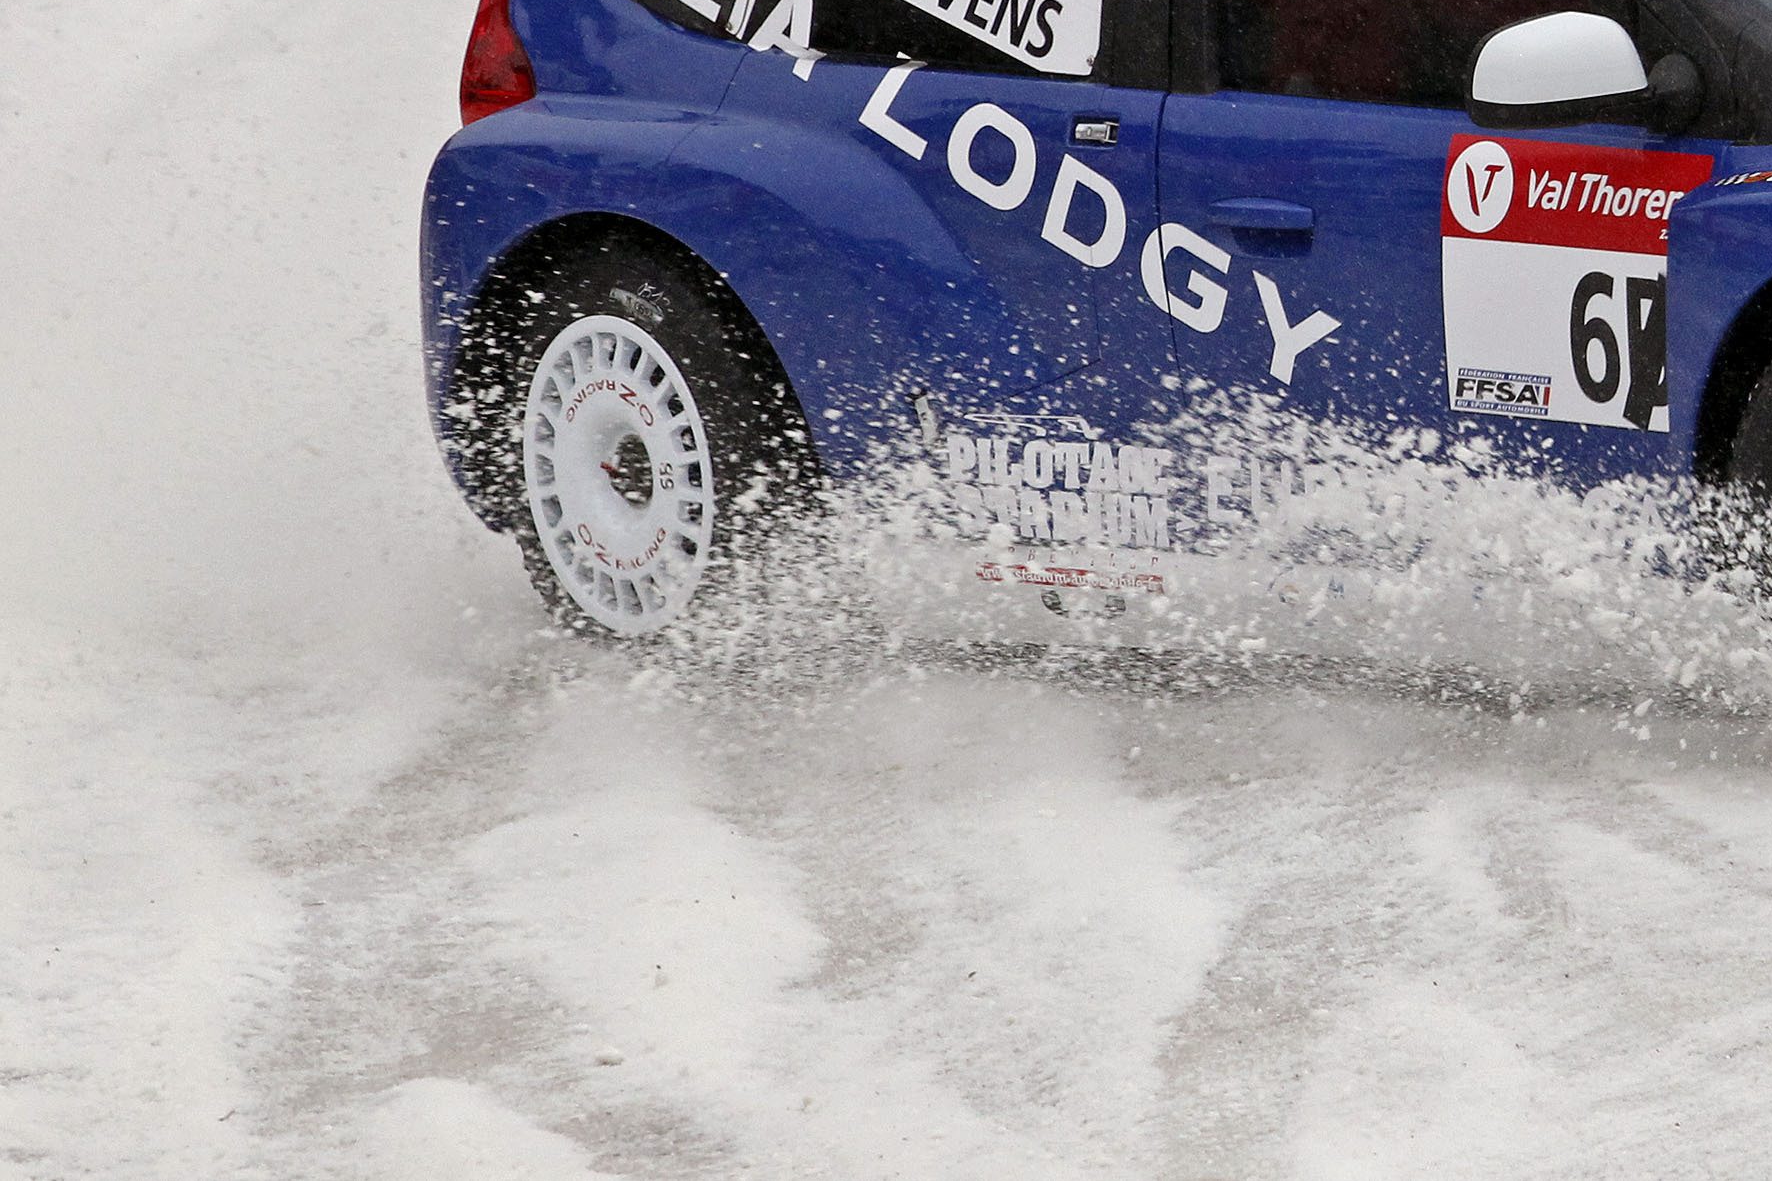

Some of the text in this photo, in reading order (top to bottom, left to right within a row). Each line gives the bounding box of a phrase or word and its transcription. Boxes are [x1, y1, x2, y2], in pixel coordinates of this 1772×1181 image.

[1527, 168, 1577, 211] Val
[859, 51, 1343, 386] LODGY
[1456, 378, 1539, 405] FFSA
